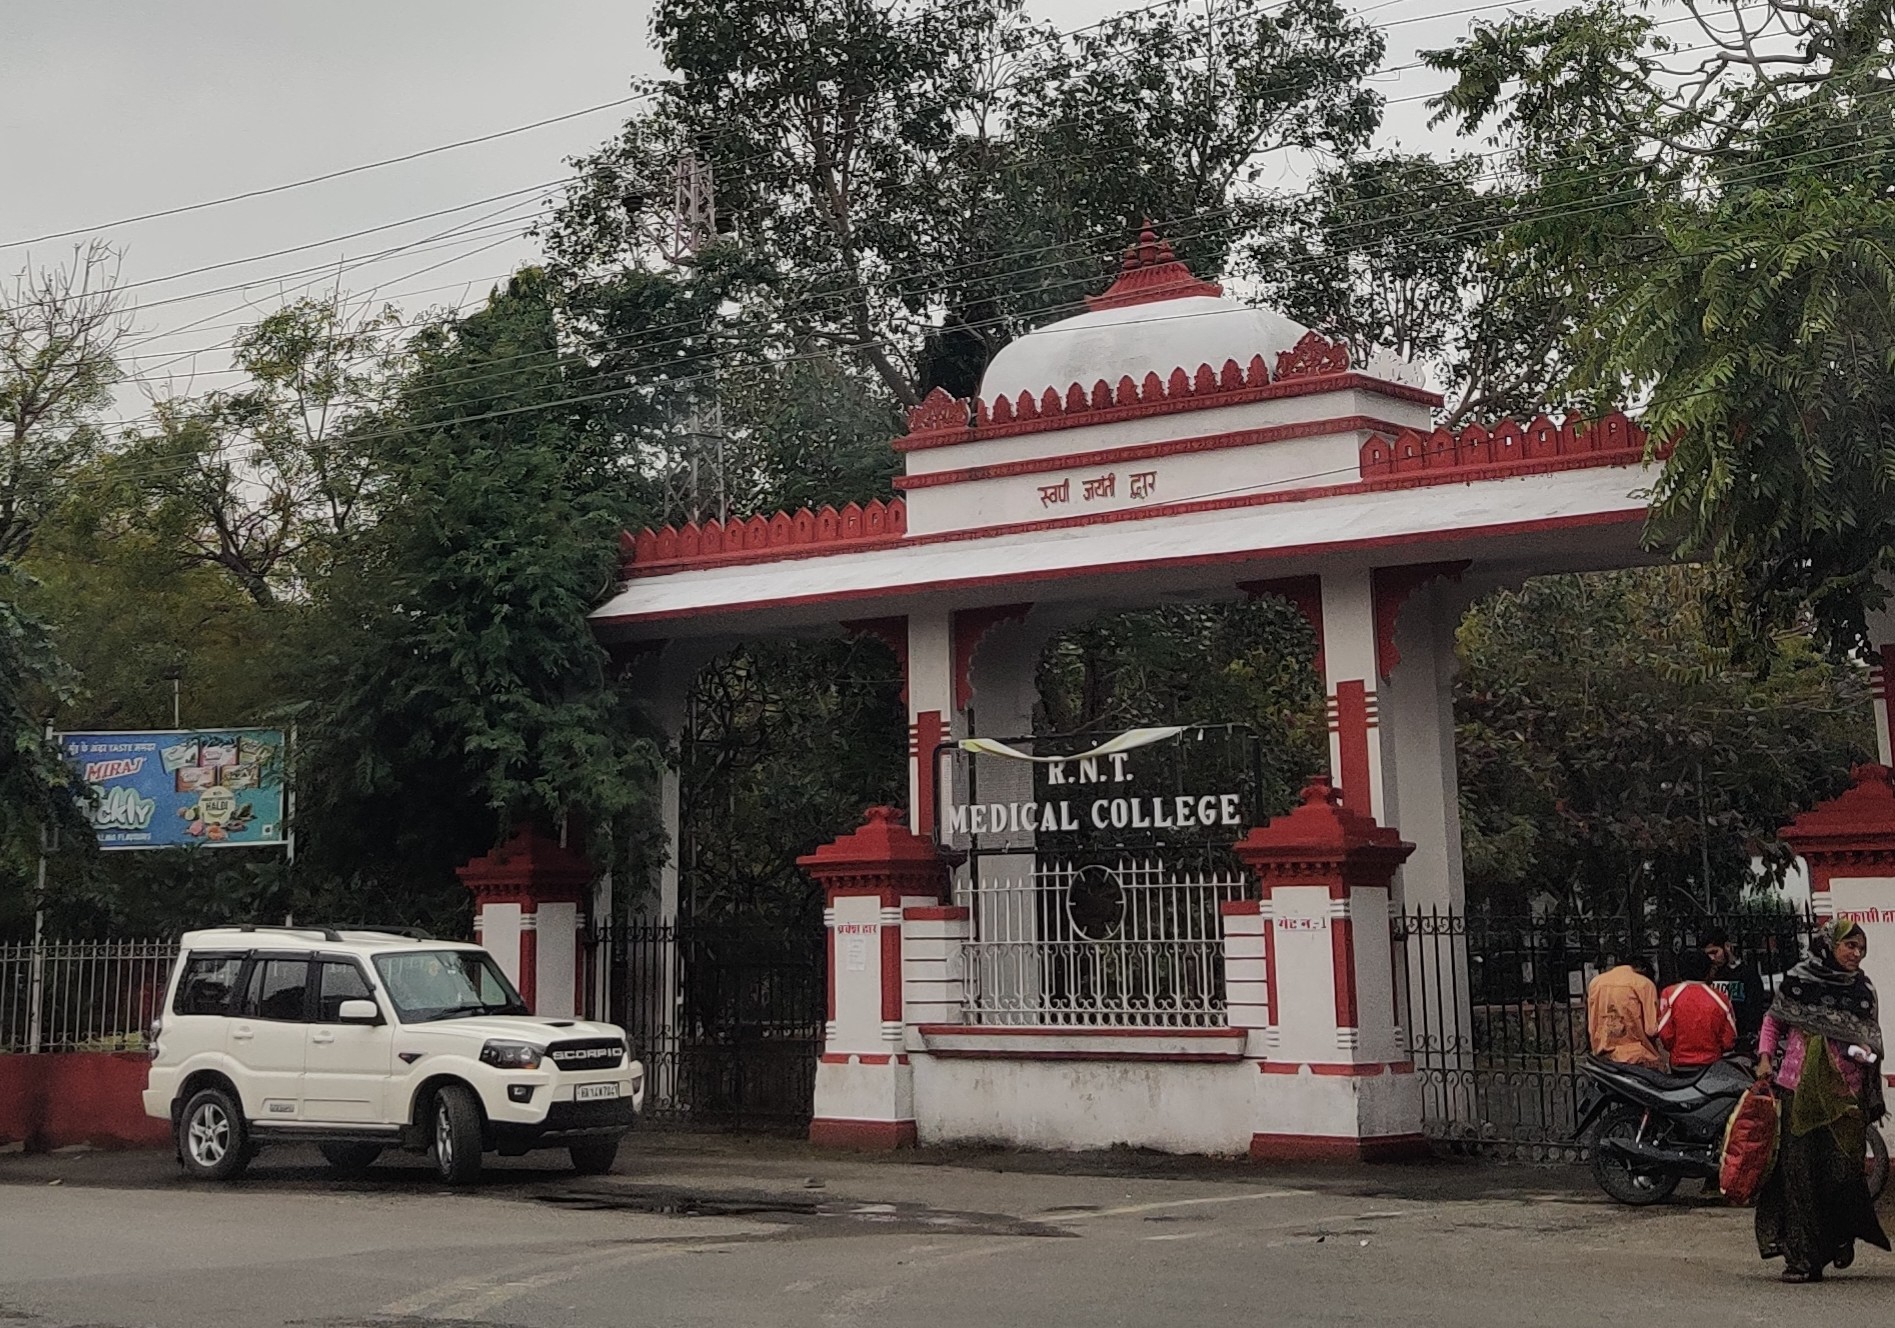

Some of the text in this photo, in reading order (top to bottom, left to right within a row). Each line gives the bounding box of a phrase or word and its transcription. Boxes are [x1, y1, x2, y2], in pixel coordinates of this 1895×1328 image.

[1082, 472, 1116, 502] जयंती
[1128, 470, 1158, 500] द्वार
[85, 757, 143, 782] MIRAJ
[947, 793, 1243, 833] MEDICAL COLLEGE
[552, 1047, 624, 1061] SCORPIO
